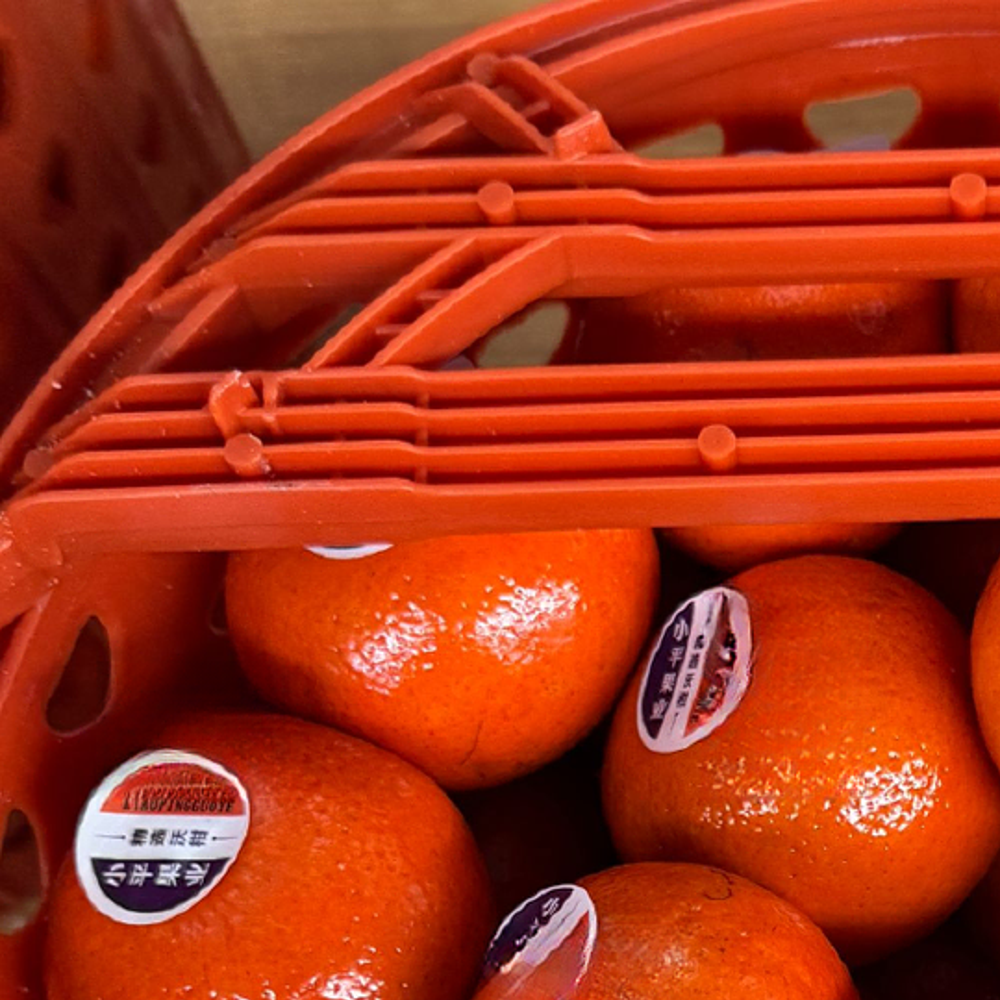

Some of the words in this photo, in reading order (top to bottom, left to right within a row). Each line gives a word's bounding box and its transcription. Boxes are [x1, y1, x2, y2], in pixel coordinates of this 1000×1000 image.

[130, 828, 210, 847] 精选沃柑
[102, 862, 211, 887] 小平果业
